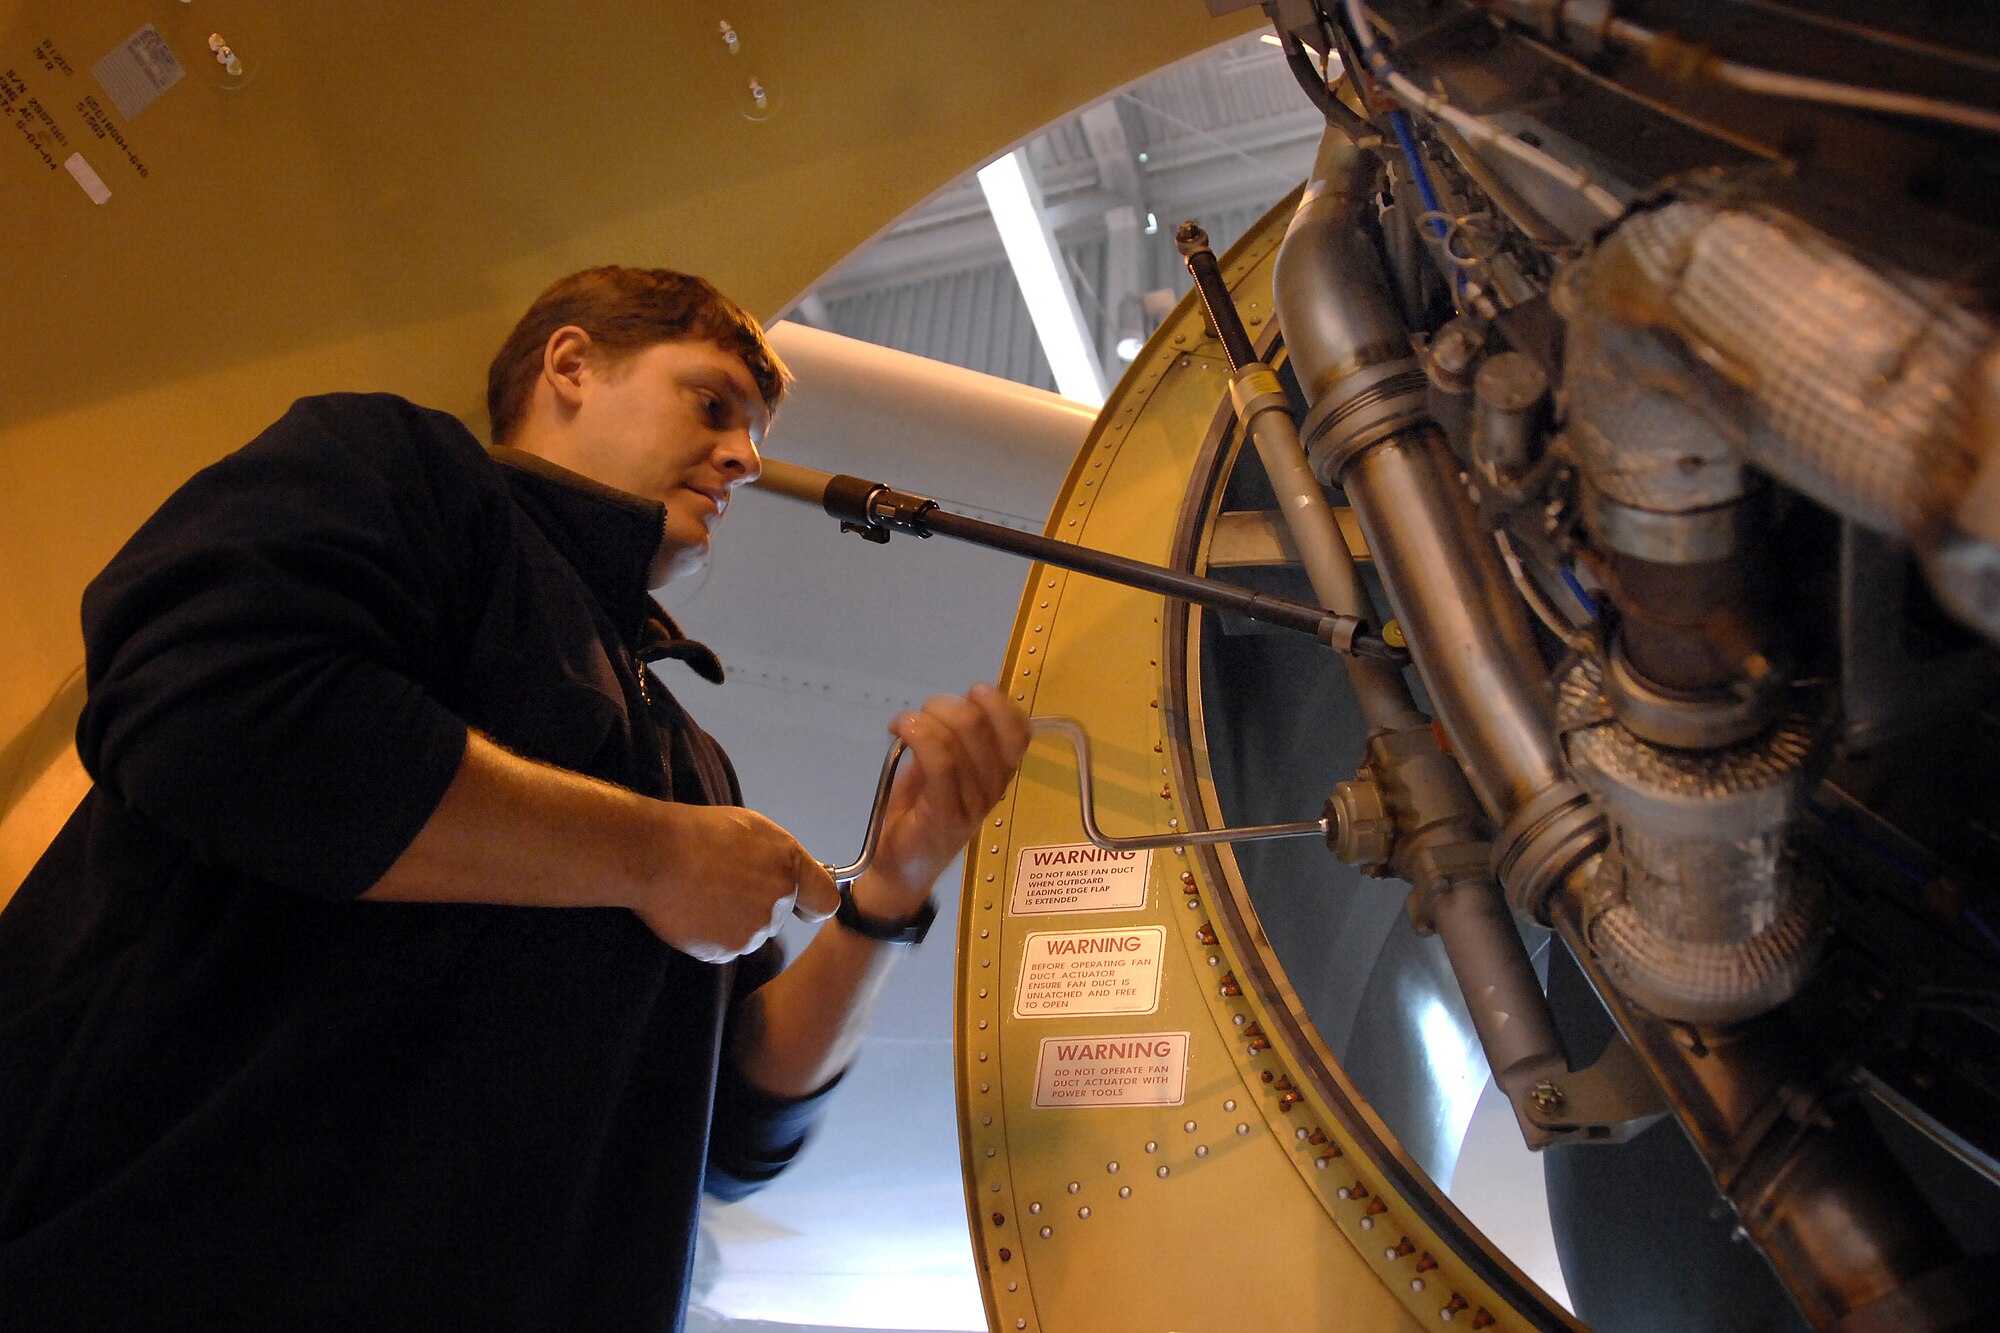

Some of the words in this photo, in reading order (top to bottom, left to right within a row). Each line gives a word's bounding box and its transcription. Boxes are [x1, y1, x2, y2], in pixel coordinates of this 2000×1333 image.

[6, 69, 28, 94] S/N
[1034, 849, 1136, 866] WARNING
[1057, 878, 1104, 886] OUTBOARD
[1027, 888, 1063, 896] LEADING
[1035, 896, 1078, 904] EXTENDED
[1047, 937, 1141, 955] WARNING
[1071, 960, 1125, 969] OPERATING
[1062, 970, 1115, 979] ACTUATOR
[1027, 991, 1082, 999] UNLATCHED
[1058, 1042, 1171, 1061] WARNING
[1101, 1067, 1143, 1075] OPERATE
